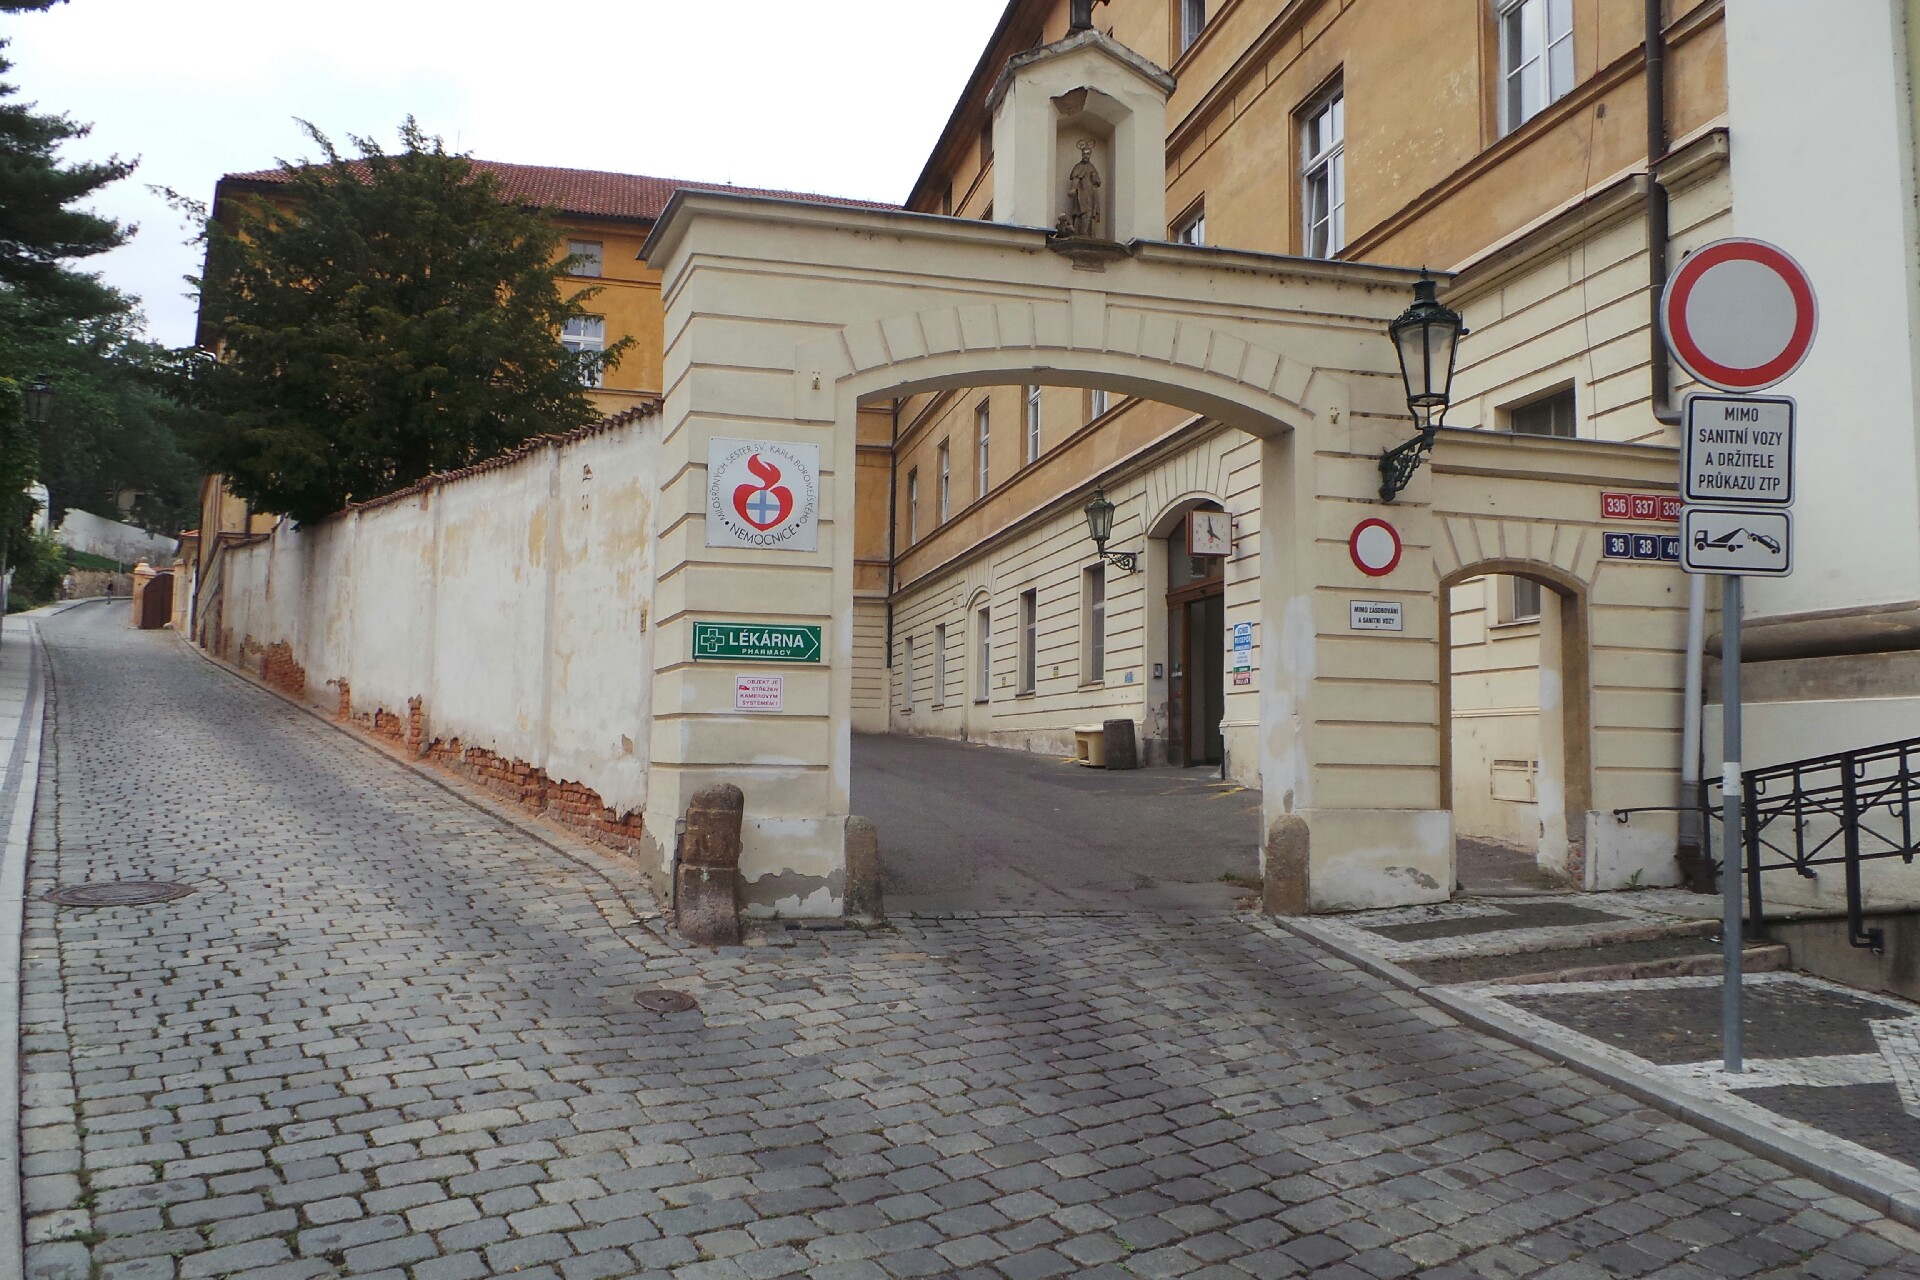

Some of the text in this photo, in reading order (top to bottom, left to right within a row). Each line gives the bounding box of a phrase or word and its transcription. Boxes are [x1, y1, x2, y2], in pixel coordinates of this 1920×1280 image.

[1724, 407, 1759, 422] MIMO
[1699, 427, 1783, 446] SANITNÍ VOZY
[726, 445, 752, 464] SESTER
[769, 445, 794, 463] KARLA
[1705, 450, 1774, 468] A DRŽITELE
[1698, 471, 1781, 491] PRŮKAZU ZTP
[1607, 498, 1626, 513] 336
[1635, 500, 1654, 514] 337
[729, 523, 797, 546] NEMOCNICE
[1612, 538, 1625, 553] 36
[1639, 539, 1652, 554] 38
[1667, 541, 1680, 556] 40
[729, 629, 804, 648] LÉKÁRNA
[742, 648, 791, 656] PHARMACY
